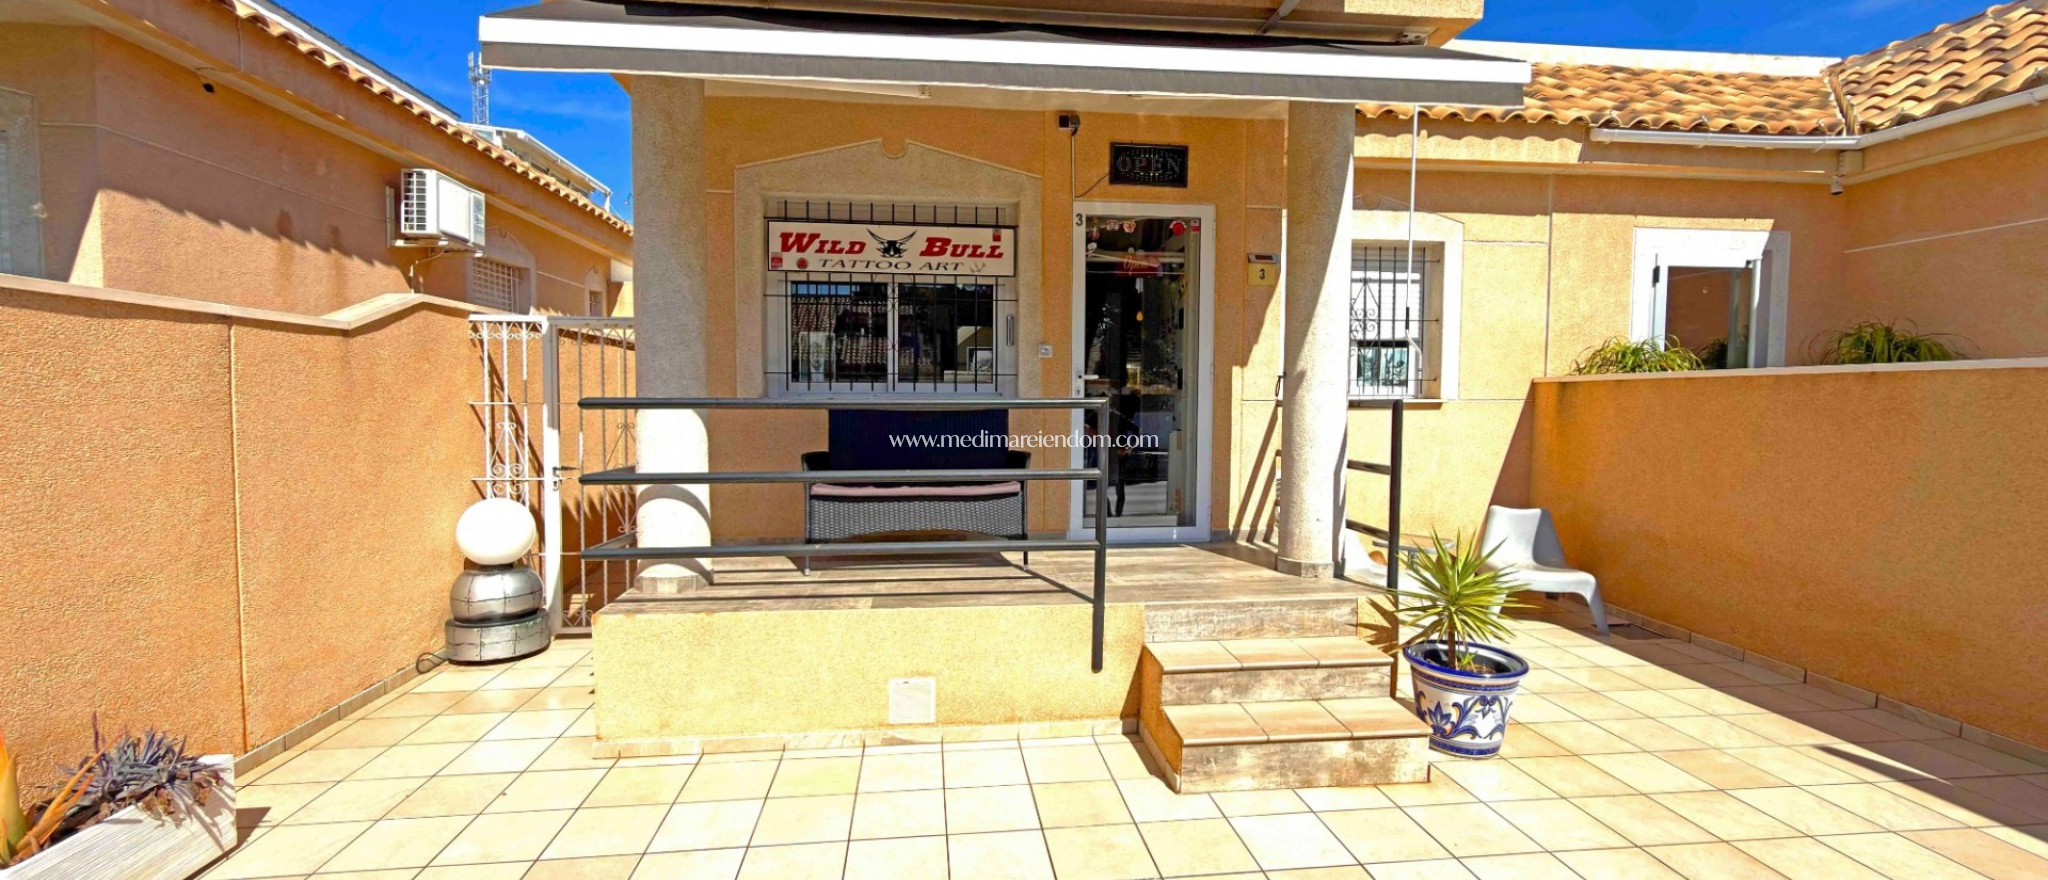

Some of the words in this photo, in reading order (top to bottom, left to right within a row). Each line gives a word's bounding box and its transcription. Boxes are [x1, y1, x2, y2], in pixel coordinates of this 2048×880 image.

[1117, 155, 1181, 173] OPEN
[1075, 213, 1084, 226] 3
[818, 258, 911, 271] TATTOO
[919, 261, 964, 272] ART
[1259, 268, 1266, 280] 3
